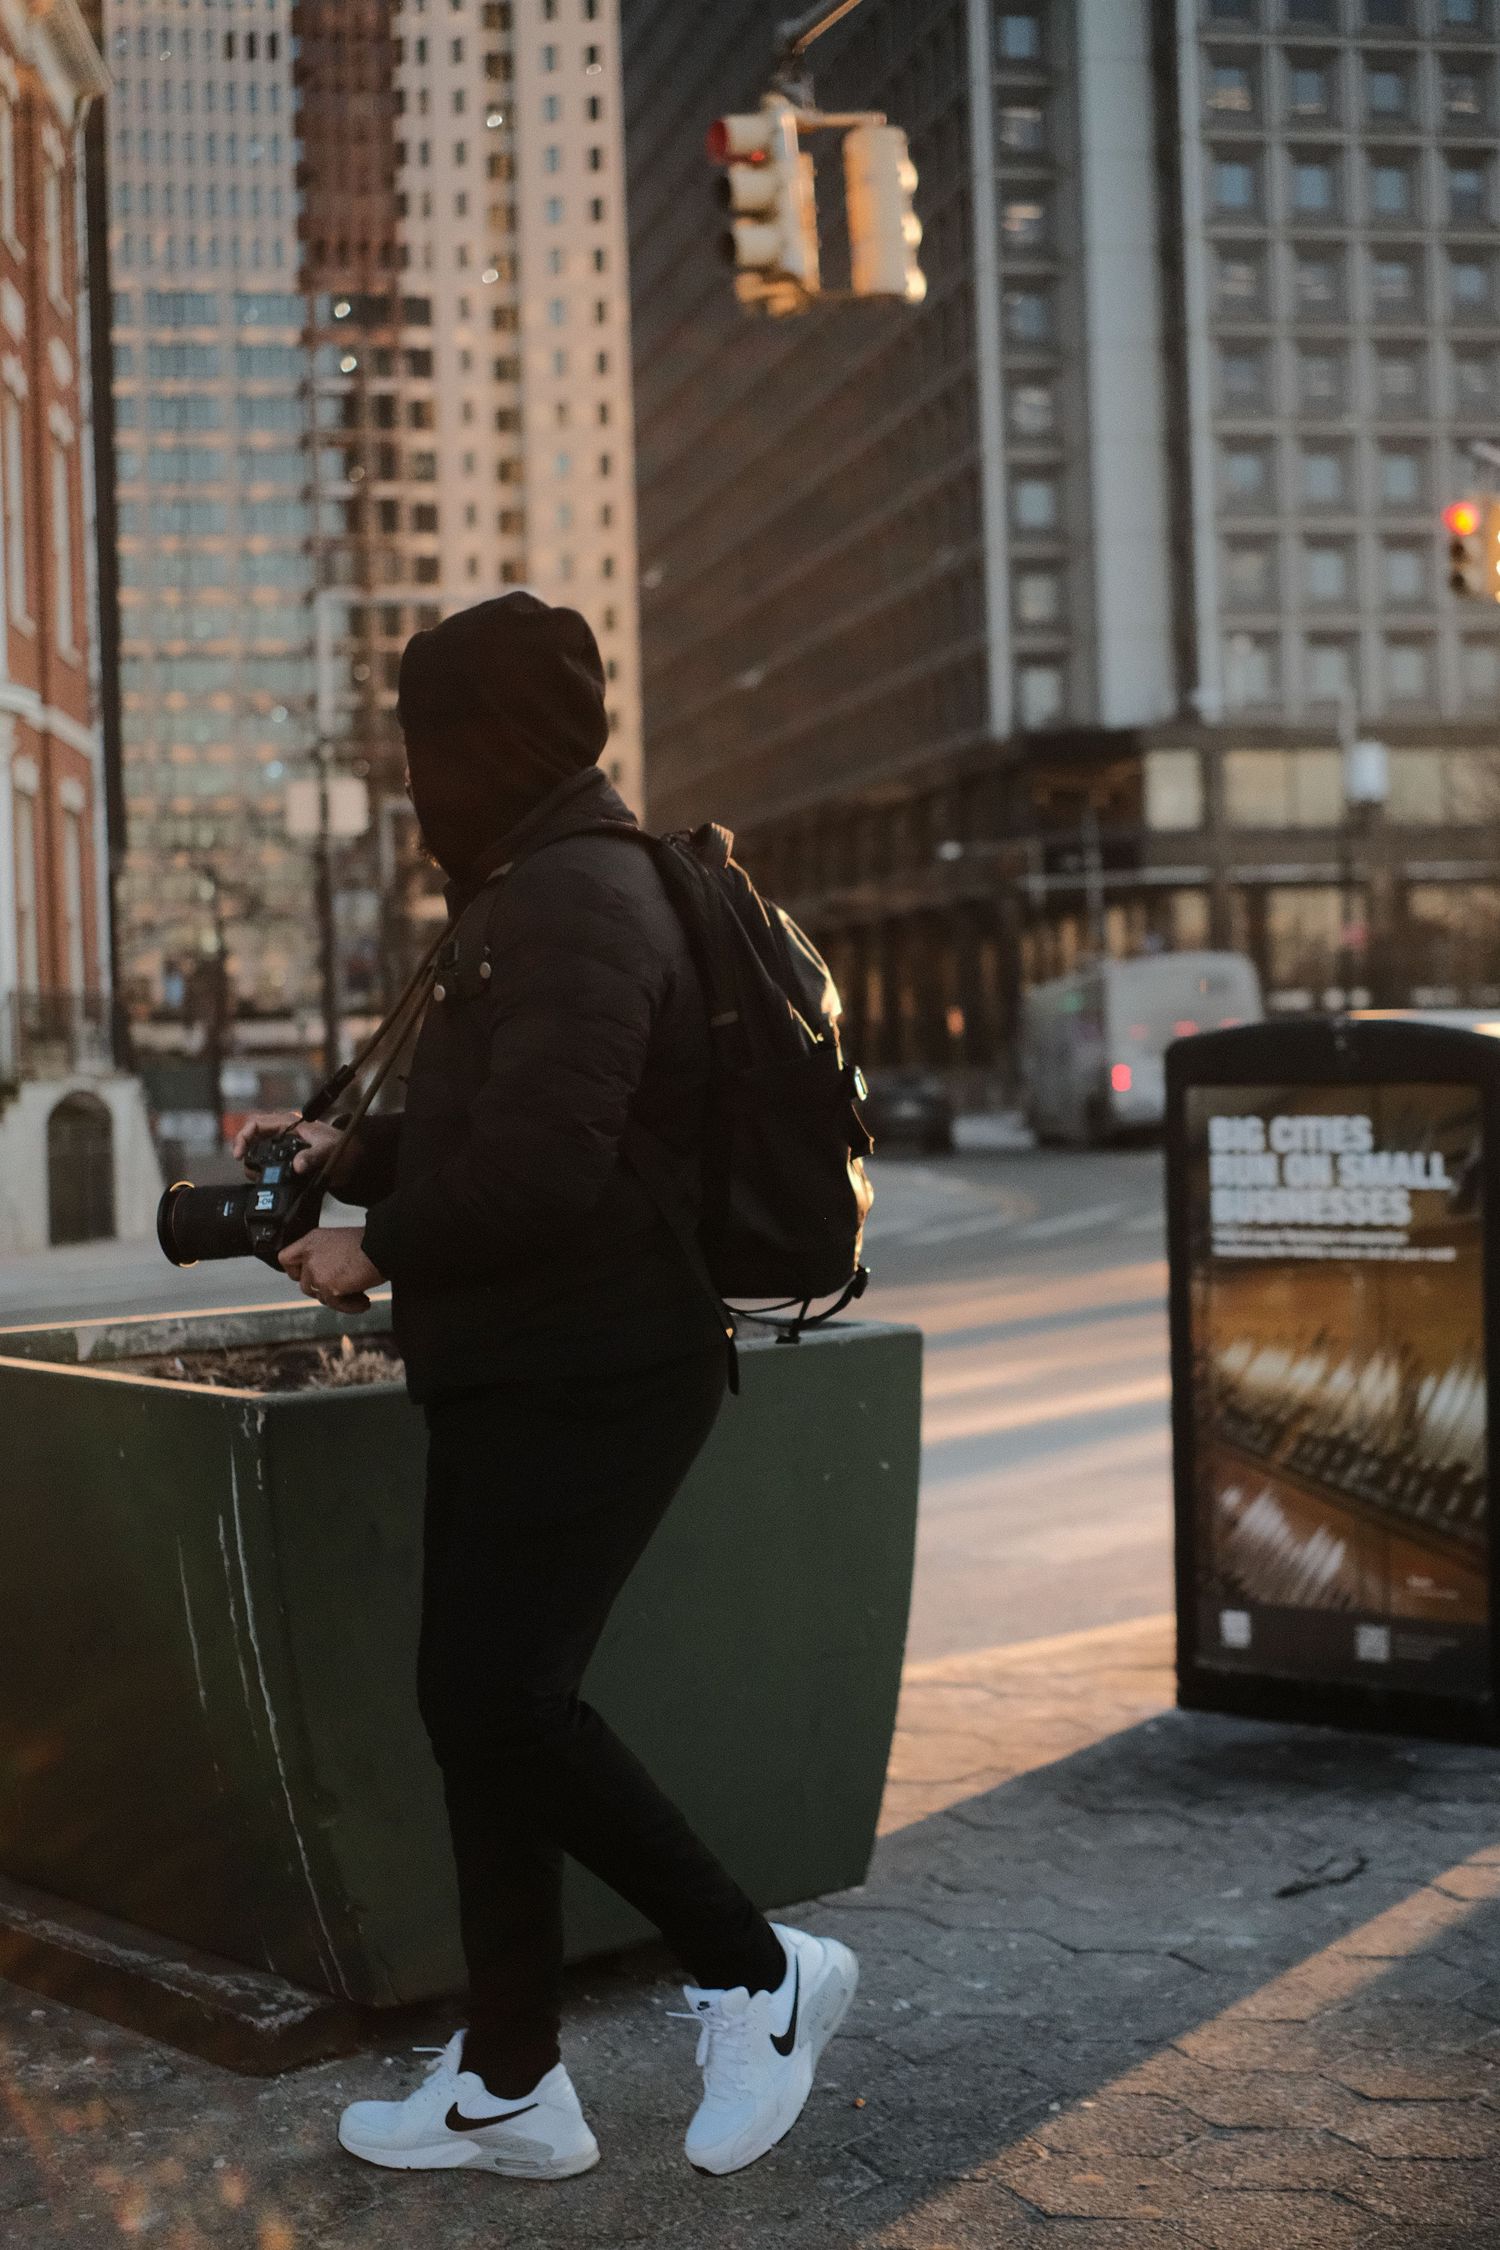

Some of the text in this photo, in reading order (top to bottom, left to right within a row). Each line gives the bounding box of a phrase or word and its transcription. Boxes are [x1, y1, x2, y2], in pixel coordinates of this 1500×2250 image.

[1208, 1115, 1374, 1153] BIG CITIES
[1209, 1151, 1455, 1189] RUN ON SMALL
[1210, 1188, 1412, 1226] BUSINESSES
